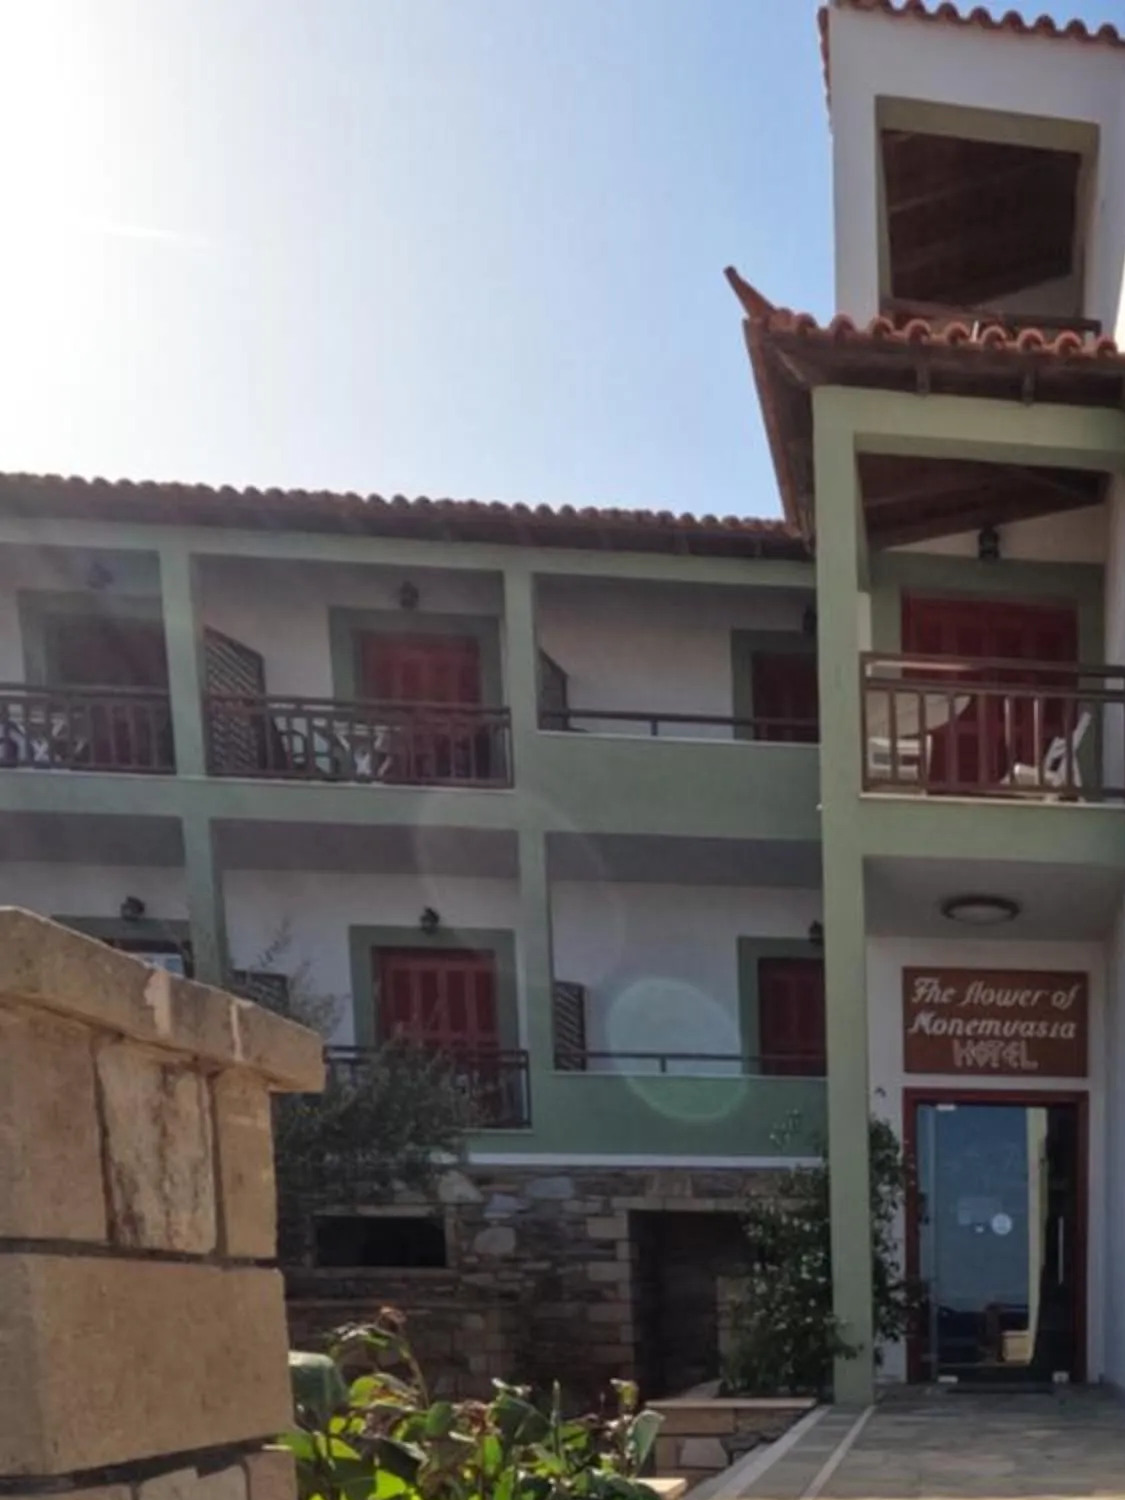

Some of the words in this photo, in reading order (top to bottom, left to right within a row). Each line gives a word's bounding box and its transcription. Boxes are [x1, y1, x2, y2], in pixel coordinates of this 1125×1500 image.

[911, 975, 957, 1004] The
[957, 980, 1049, 1007] flower
[1052, 983, 1081, 1011] of
[953, 1038, 1039, 1070] HOTEL
